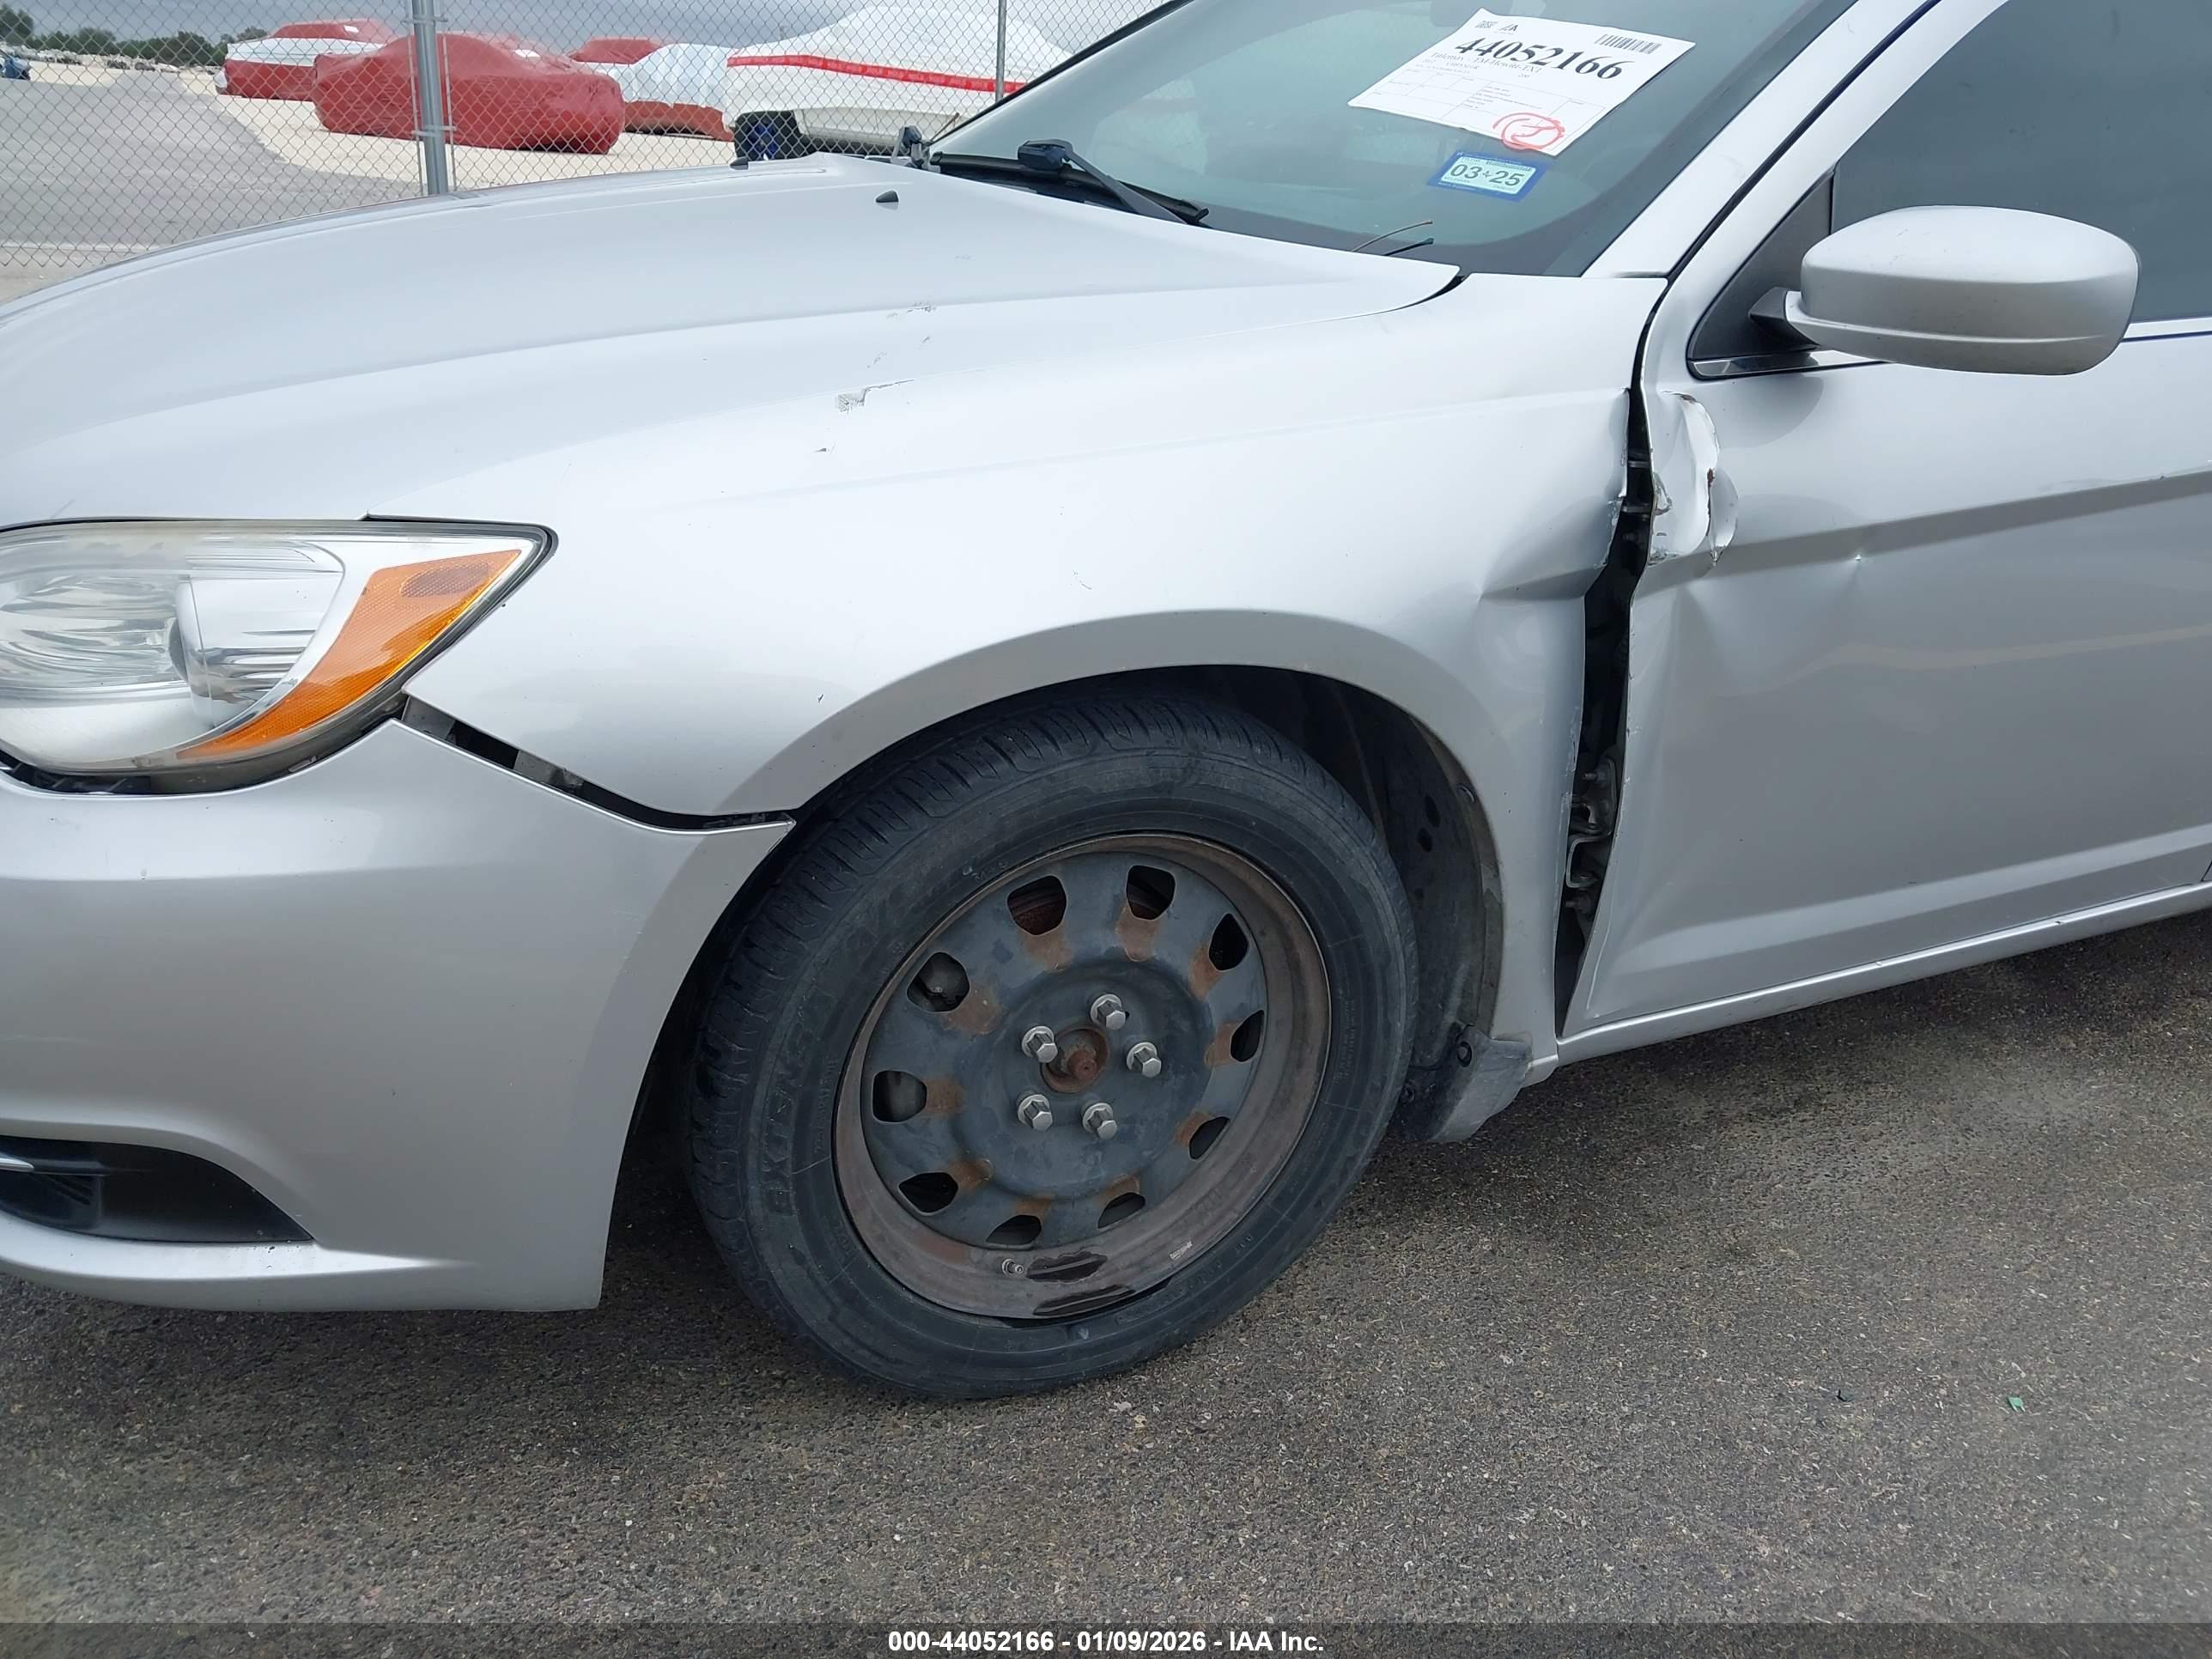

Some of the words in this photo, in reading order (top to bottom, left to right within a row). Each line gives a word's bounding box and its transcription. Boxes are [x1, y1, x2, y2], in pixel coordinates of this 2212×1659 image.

[1455, 37, 1635, 80] 44052166
[1450, 164, 1483, 179] 03
[1489, 170, 1525, 186] 25
